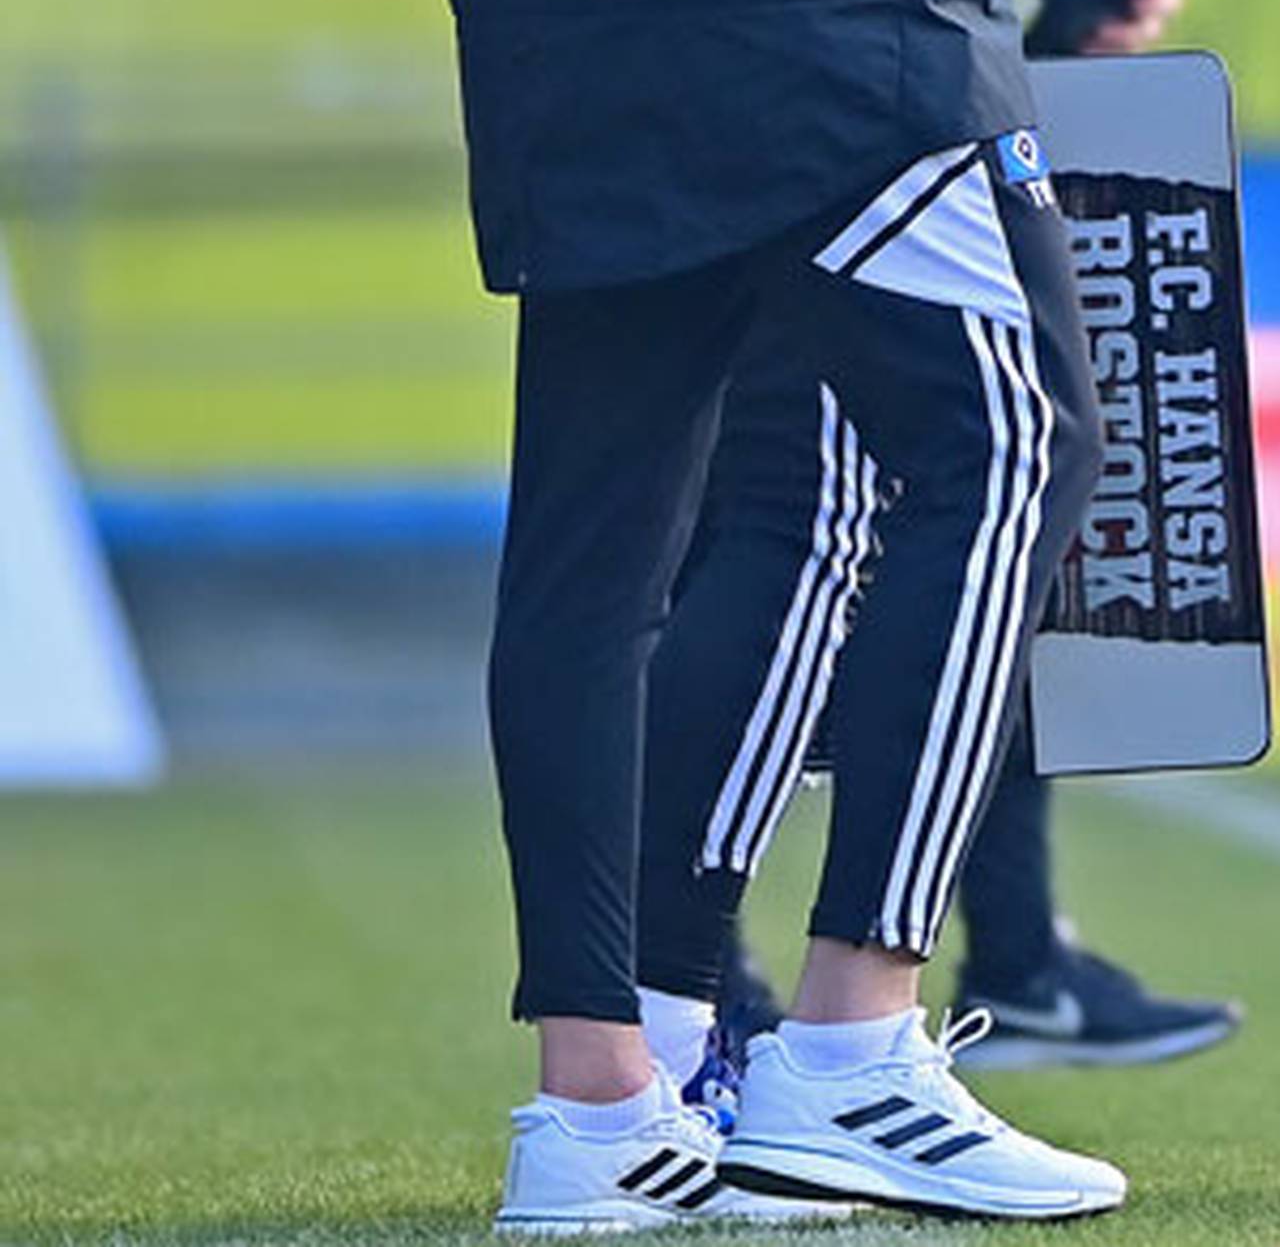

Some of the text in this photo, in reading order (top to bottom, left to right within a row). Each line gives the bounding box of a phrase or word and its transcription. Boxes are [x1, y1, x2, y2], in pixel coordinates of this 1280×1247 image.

[1066, 214, 1155, 611] ROSTOCK
[1146, 208, 1231, 611] F.C. HANSA
